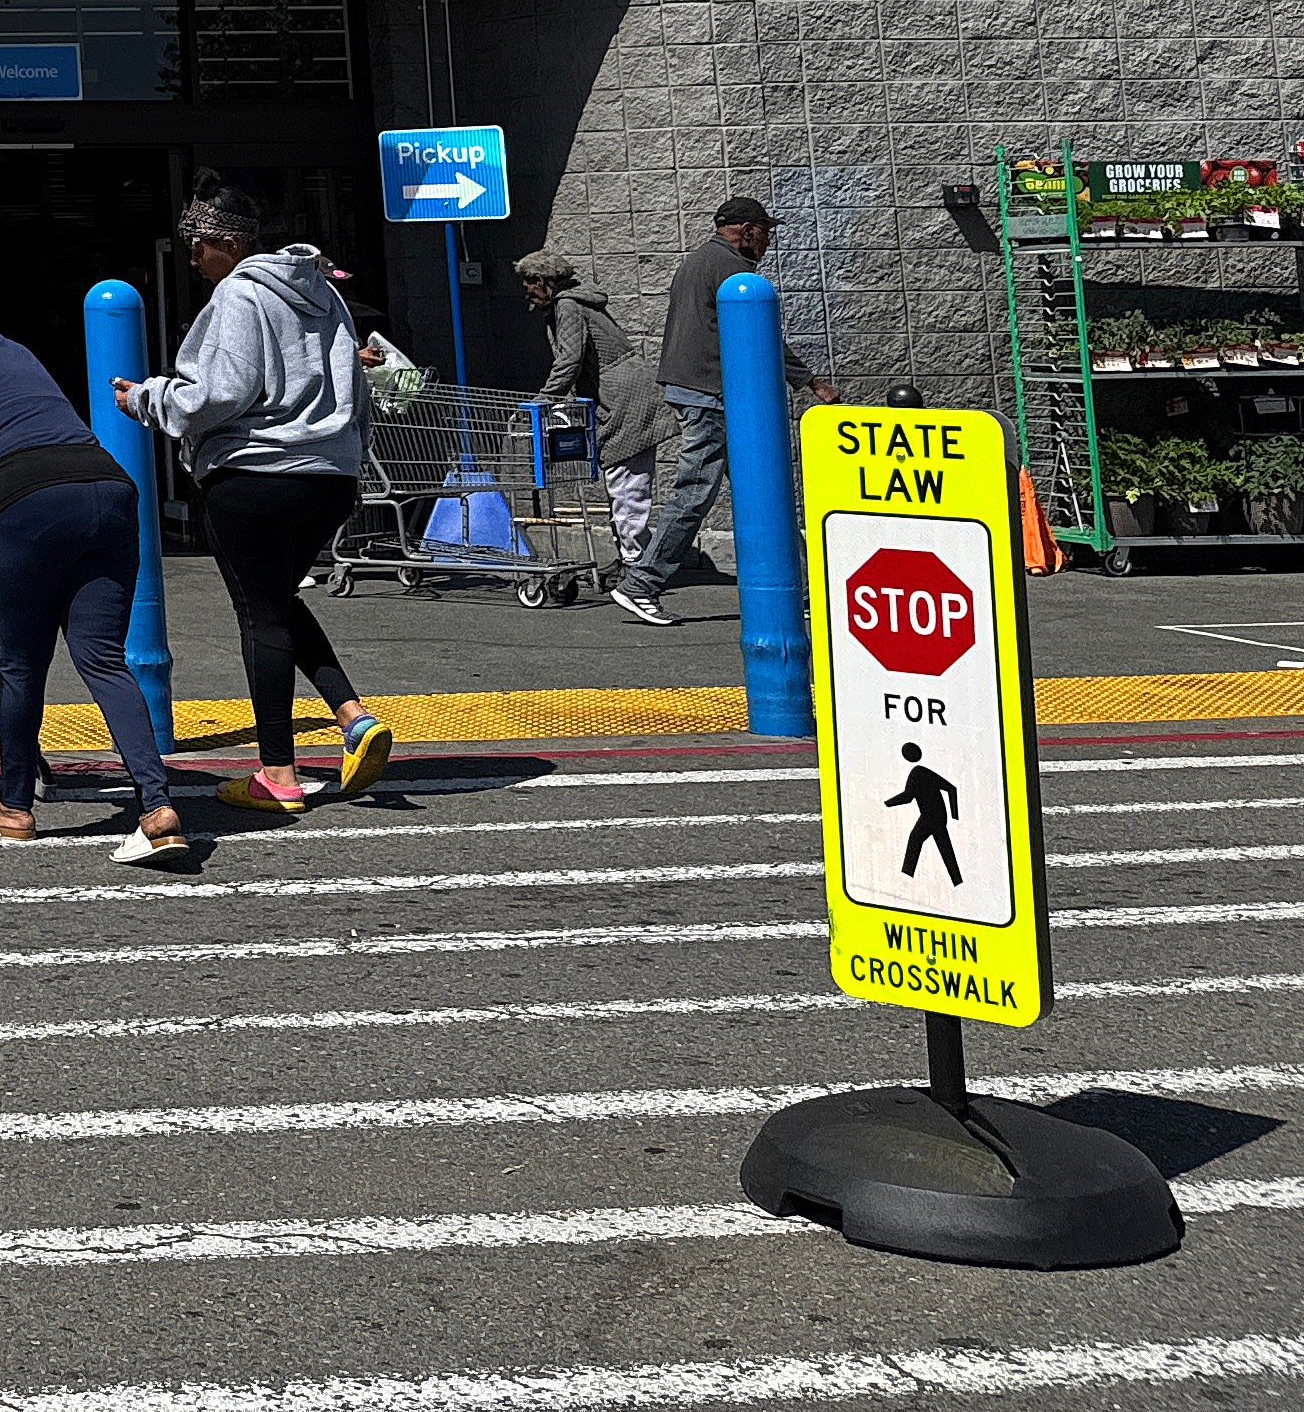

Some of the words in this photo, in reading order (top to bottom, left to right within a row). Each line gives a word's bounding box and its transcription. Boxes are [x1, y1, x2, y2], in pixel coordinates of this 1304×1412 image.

[397, 142, 485, 168] Pickup
[1106, 164, 1144, 179] GROW
[1148, 164, 1184, 179] YOUR
[1109, 178, 1182, 194] GROCERIES
[837, 421, 965, 460] STATE
[859, 468, 943, 504] LAW
[853, 584, 968, 638] STOP
[884, 693, 947, 726] FOR
[885, 922, 979, 964] WITHIN
[850, 956, 1018, 1009] CROSSWALK
